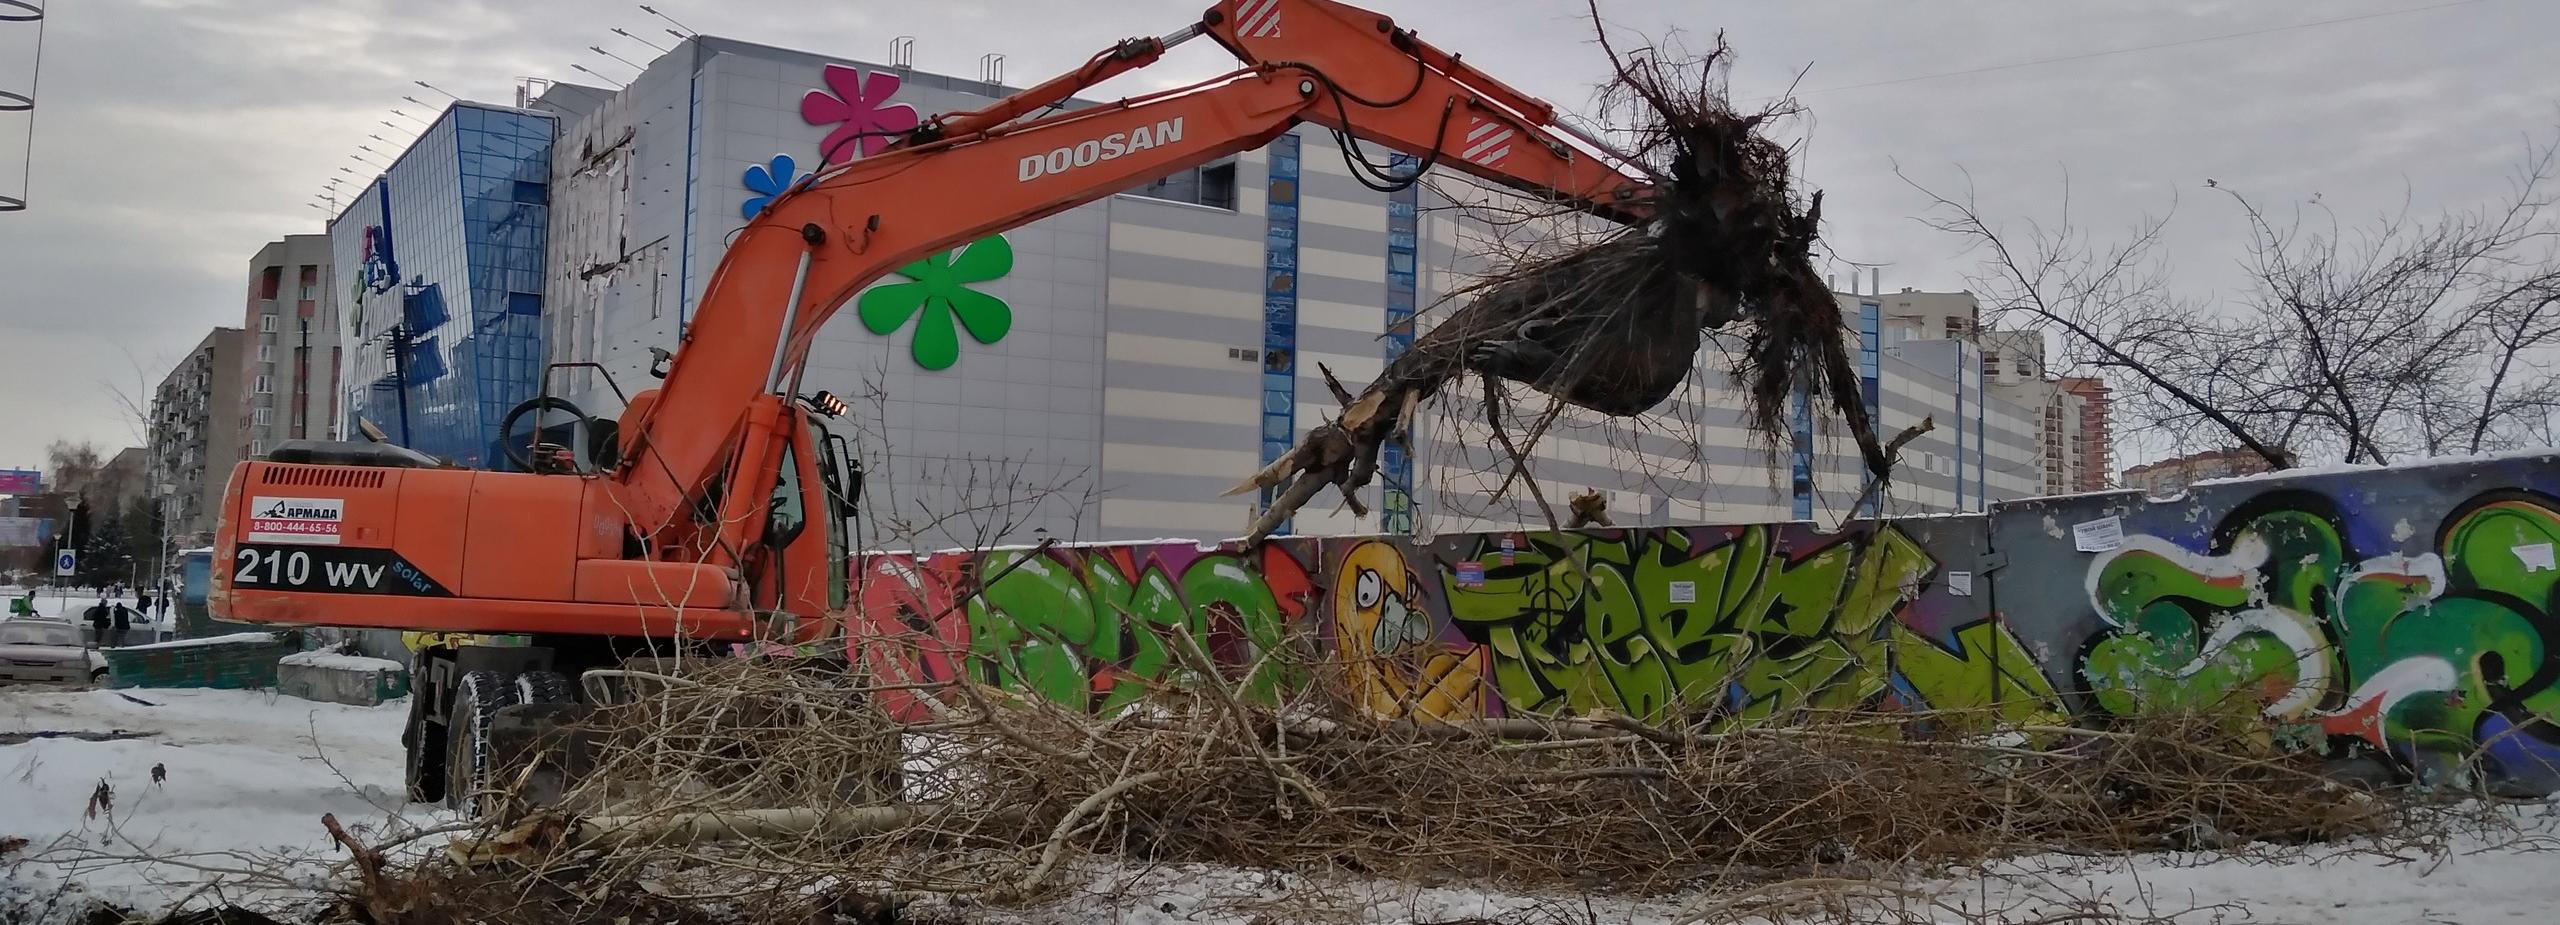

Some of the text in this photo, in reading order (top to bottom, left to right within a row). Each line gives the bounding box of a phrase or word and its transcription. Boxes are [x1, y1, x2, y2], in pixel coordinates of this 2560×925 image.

[1018, 116, 1184, 183] DOOSAN
[253, 521, 338, 533] 8-800-444-65-56
[287, 507, 337, 519] АРМАДА
[234, 548, 310, 586] 210
[393, 561, 432, 592] solar
